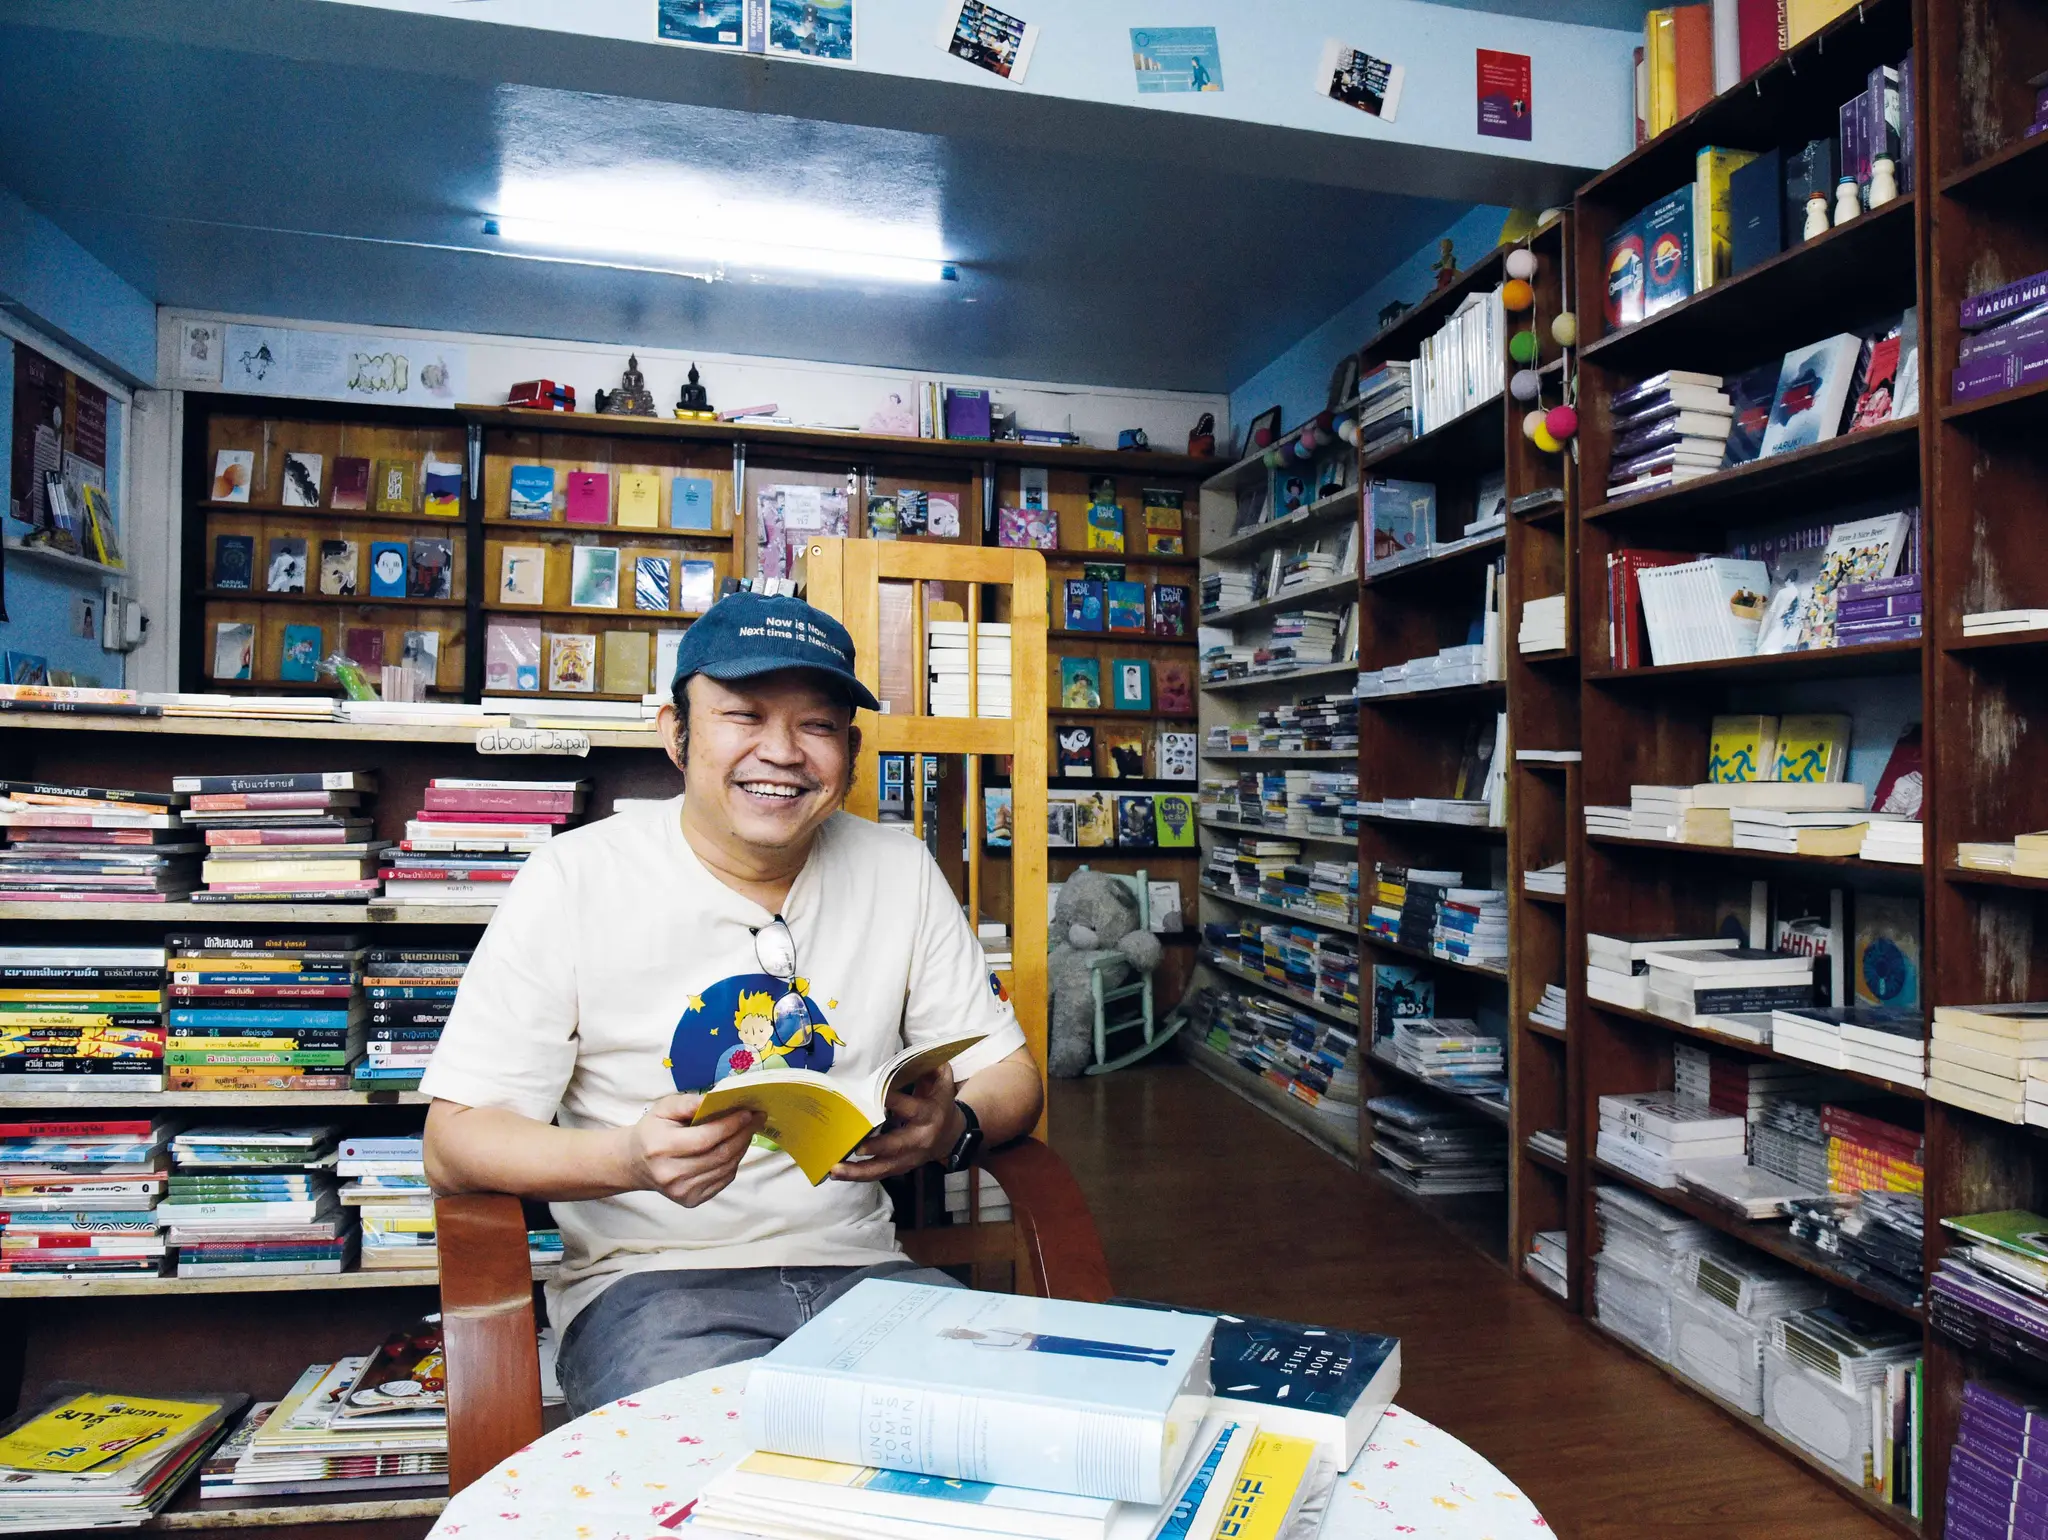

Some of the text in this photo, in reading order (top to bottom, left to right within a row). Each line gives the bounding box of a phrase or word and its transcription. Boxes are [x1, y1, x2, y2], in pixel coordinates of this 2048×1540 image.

[1977, 283, 2048, 317] HARUKI MUR
[739, 627, 766, 637] Next
[767, 628, 793, 639] time
[795, 632, 806, 642] is
[766, 617, 827, 639] Now is Now
[480, 729, 588, 755] about Japan
[1280, 1345, 1312, 1375] THIEF
[1305, 1350, 1334, 1376] BOOK
[1329, 1357, 1353, 1376] THE
[869, 1397, 884, 1460] UNCLE
[885, 1397, 898, 1461] TOM'S
[900, 1400, 914, 1464] CABIN
